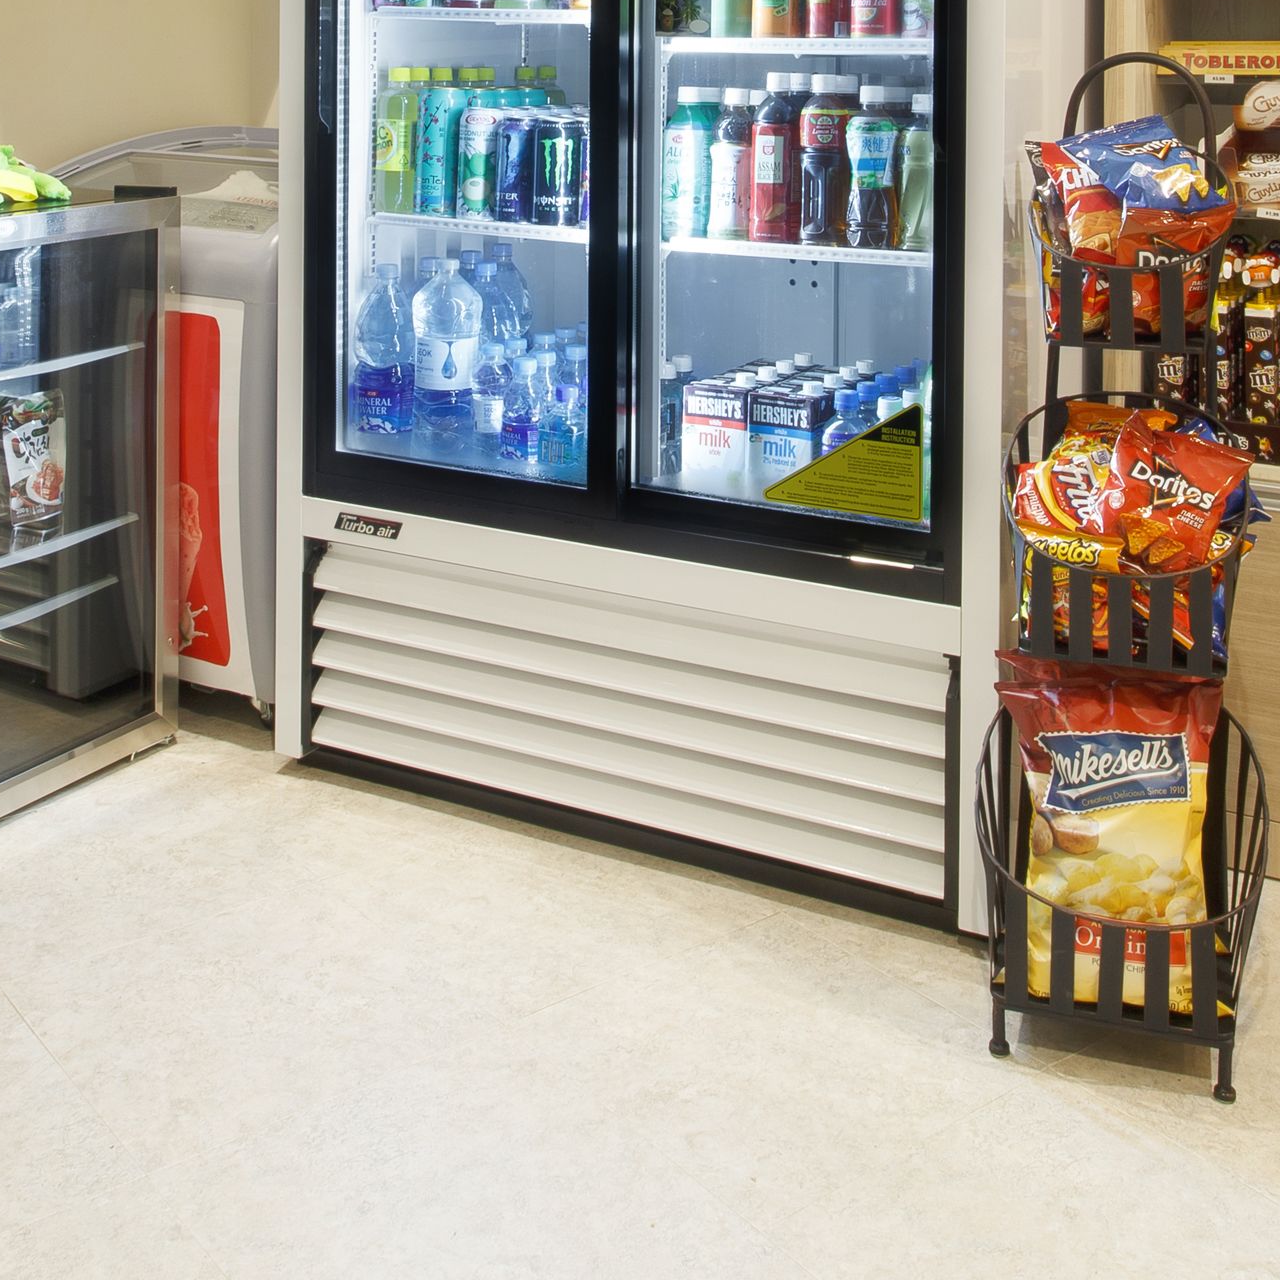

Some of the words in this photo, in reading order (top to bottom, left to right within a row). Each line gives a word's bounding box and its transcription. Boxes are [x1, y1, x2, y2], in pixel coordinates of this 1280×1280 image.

[757, 159, 782, 173] ASSAM
[360, 406, 388, 416] WATER
[697, 428, 732, 450] milk
[881, 427, 918, 437] INSTALLATION
[881, 434, 918, 445] INSTRUCTION
[761, 437, 798, 461] milk
[1130, 461, 1216, 510] Doritos
[1176, 515, 1203, 529] CHEESE
[1181, 509, 1205, 524] NACHO
[340, 518, 375, 535] Turbo
[377, 524, 396, 539] air
[1052, 740, 1175, 787] Mikesell's
[1081, 791, 1113, 808] Creating
[1113, 789, 1146, 800] Delicious
[1147, 786, 1168, 797] Since
[1169, 785, 1185, 794] 1910
